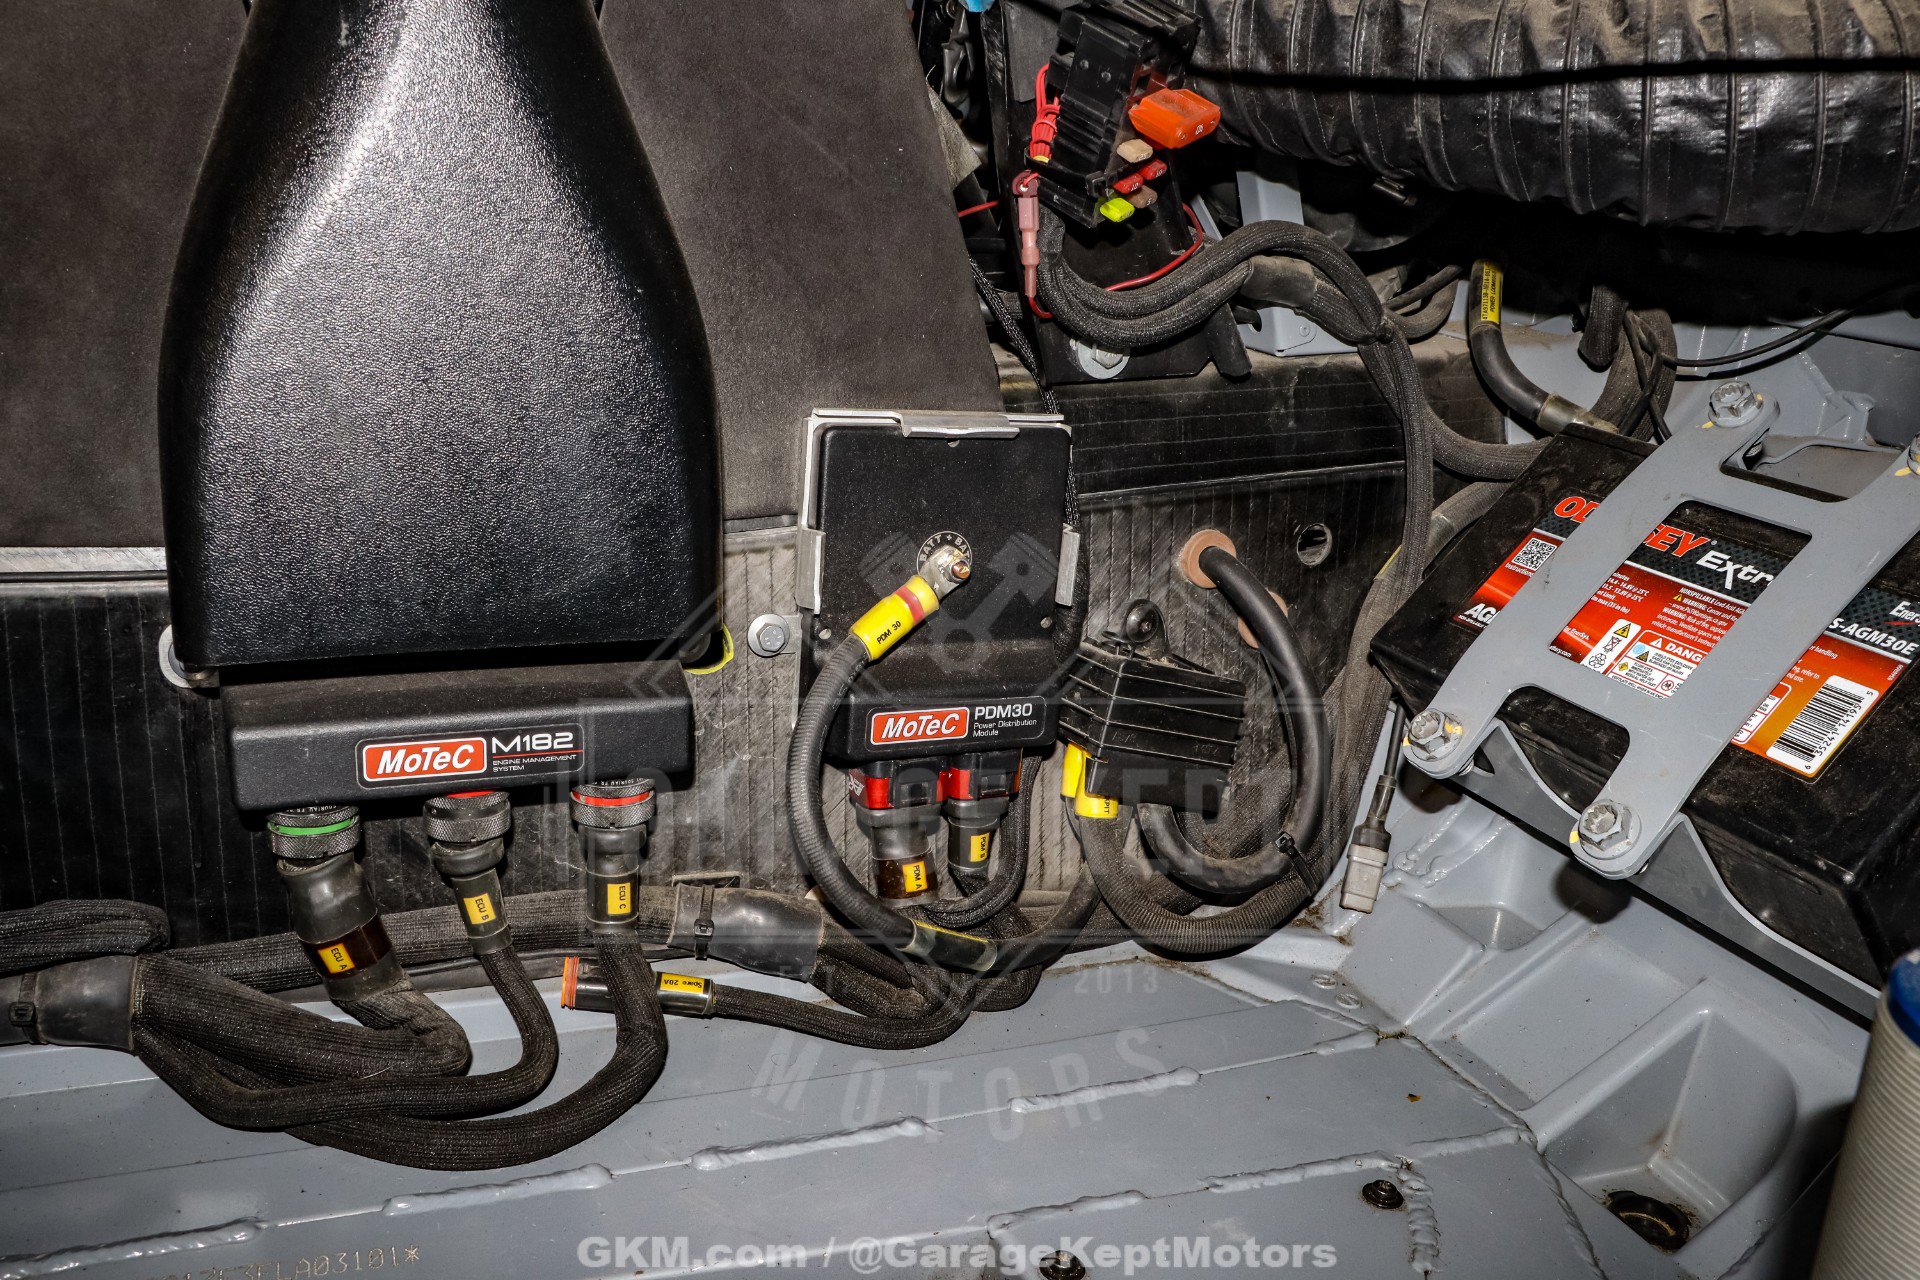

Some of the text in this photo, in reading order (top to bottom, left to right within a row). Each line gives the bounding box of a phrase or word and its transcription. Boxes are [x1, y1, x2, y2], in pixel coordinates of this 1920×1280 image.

[919, 534, 942, 561] BATT
[1643, 523, 1711, 557] EY
[1696, 550, 1774, 590] Extr
[877, 620, 902, 644] PDM 30
[1665, 642, 1706, 662] DANG
[1815, 645, 1837, 659] handling
[1801, 666, 1815, 677] refer
[881, 703, 1033, 739] MoTeC PDM30
[973, 718, 1037, 730] Power Distribution
[1814, 731, 1840, 757] 35241
[1838, 703, 1862, 728] 14195
[972, 729, 999, 738] Module
[377, 731, 573, 775] MoTeC M182
[493, 754, 577, 766] ENGINE MANAGEMENT
[913, 864, 921, 882] PDM
[475, 898, 486, 913] ECU
[331, 947, 344, 962] ECU
[682, 980, 703, 989] Spare
